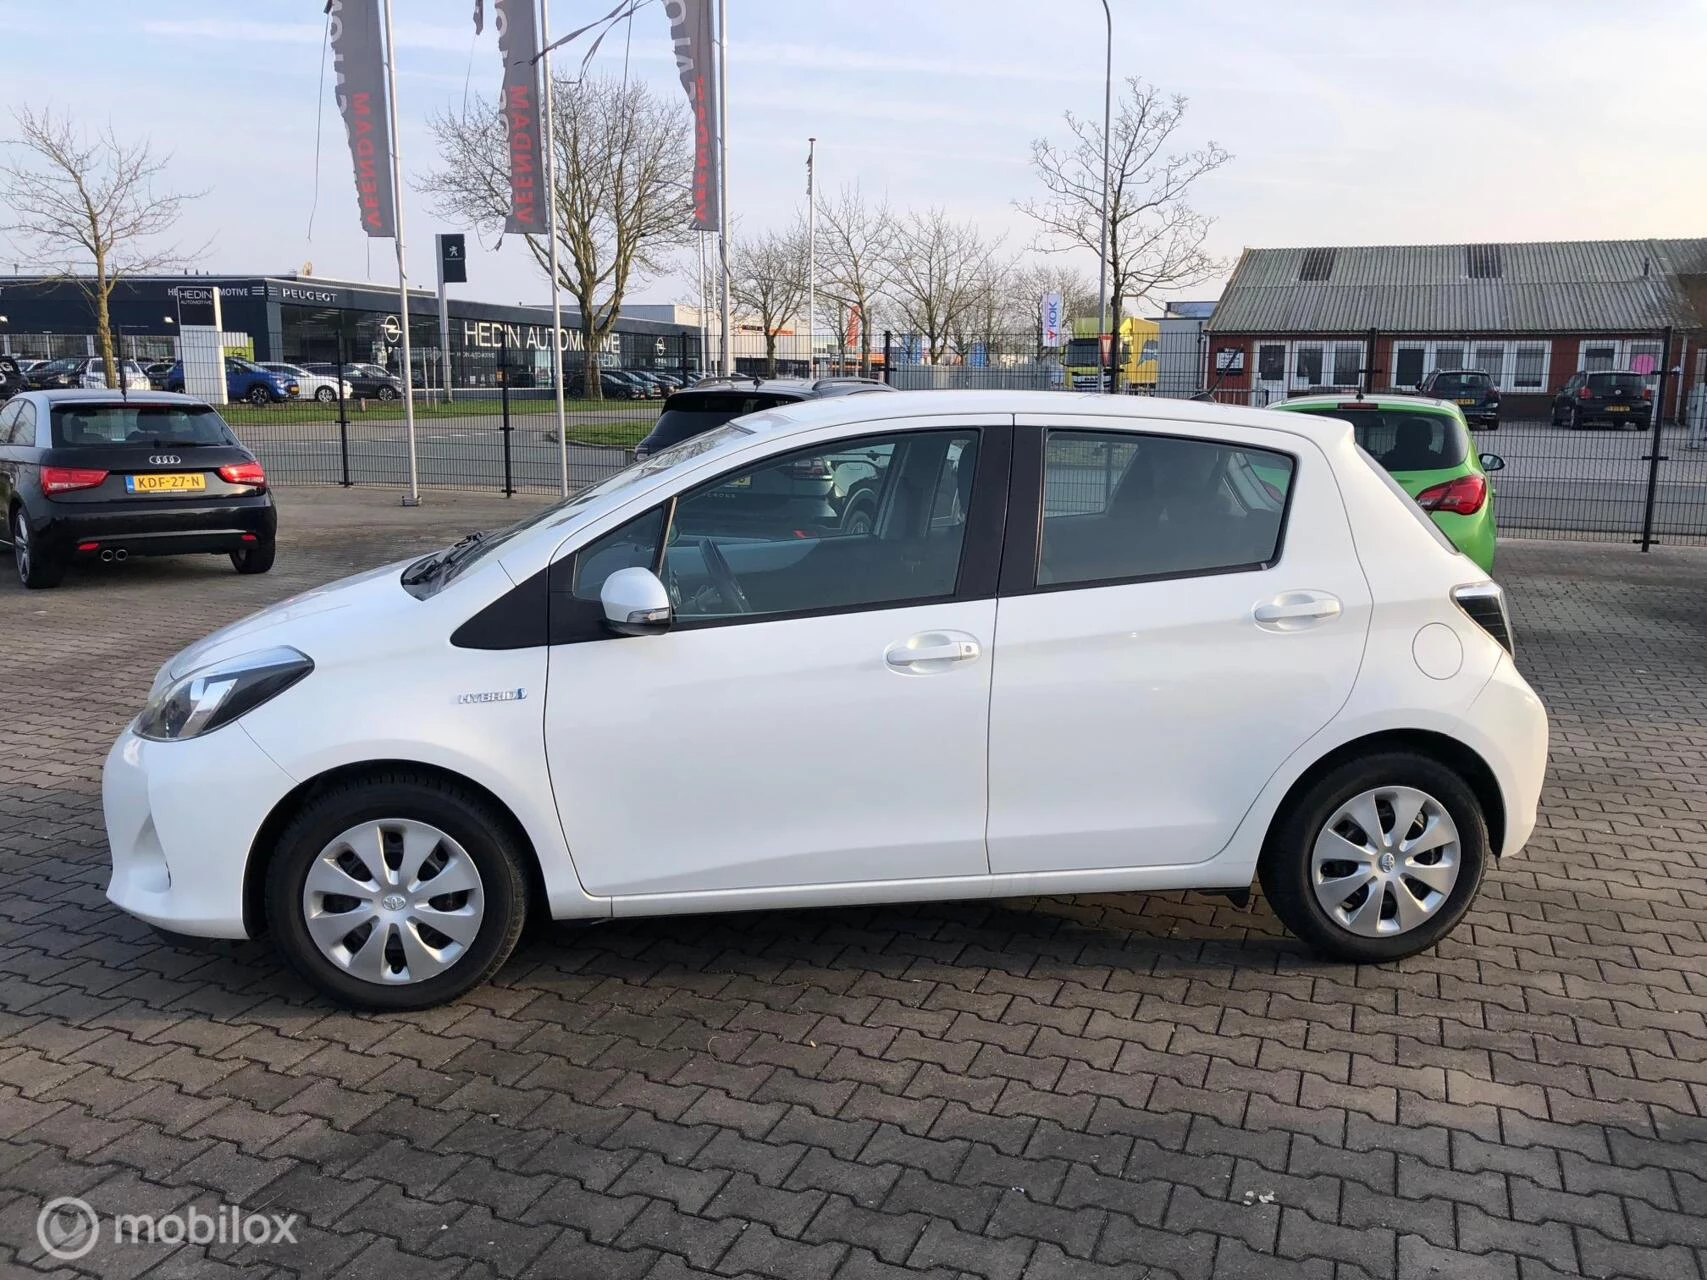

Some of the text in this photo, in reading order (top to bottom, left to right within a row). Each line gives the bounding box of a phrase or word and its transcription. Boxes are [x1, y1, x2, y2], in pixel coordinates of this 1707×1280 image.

[180, 290, 212, 299] HEDIN
[219, 288, 248, 296] MOTIVE
[283, 288, 337, 301] PEUGEOT
[1049, 302, 1057, 327] KOK
[464, 321, 621, 354] HEDIN AUTOMIVE
[138, 476, 200, 488] KDF-27-N
[457, 691, 516, 704] HYBRID
